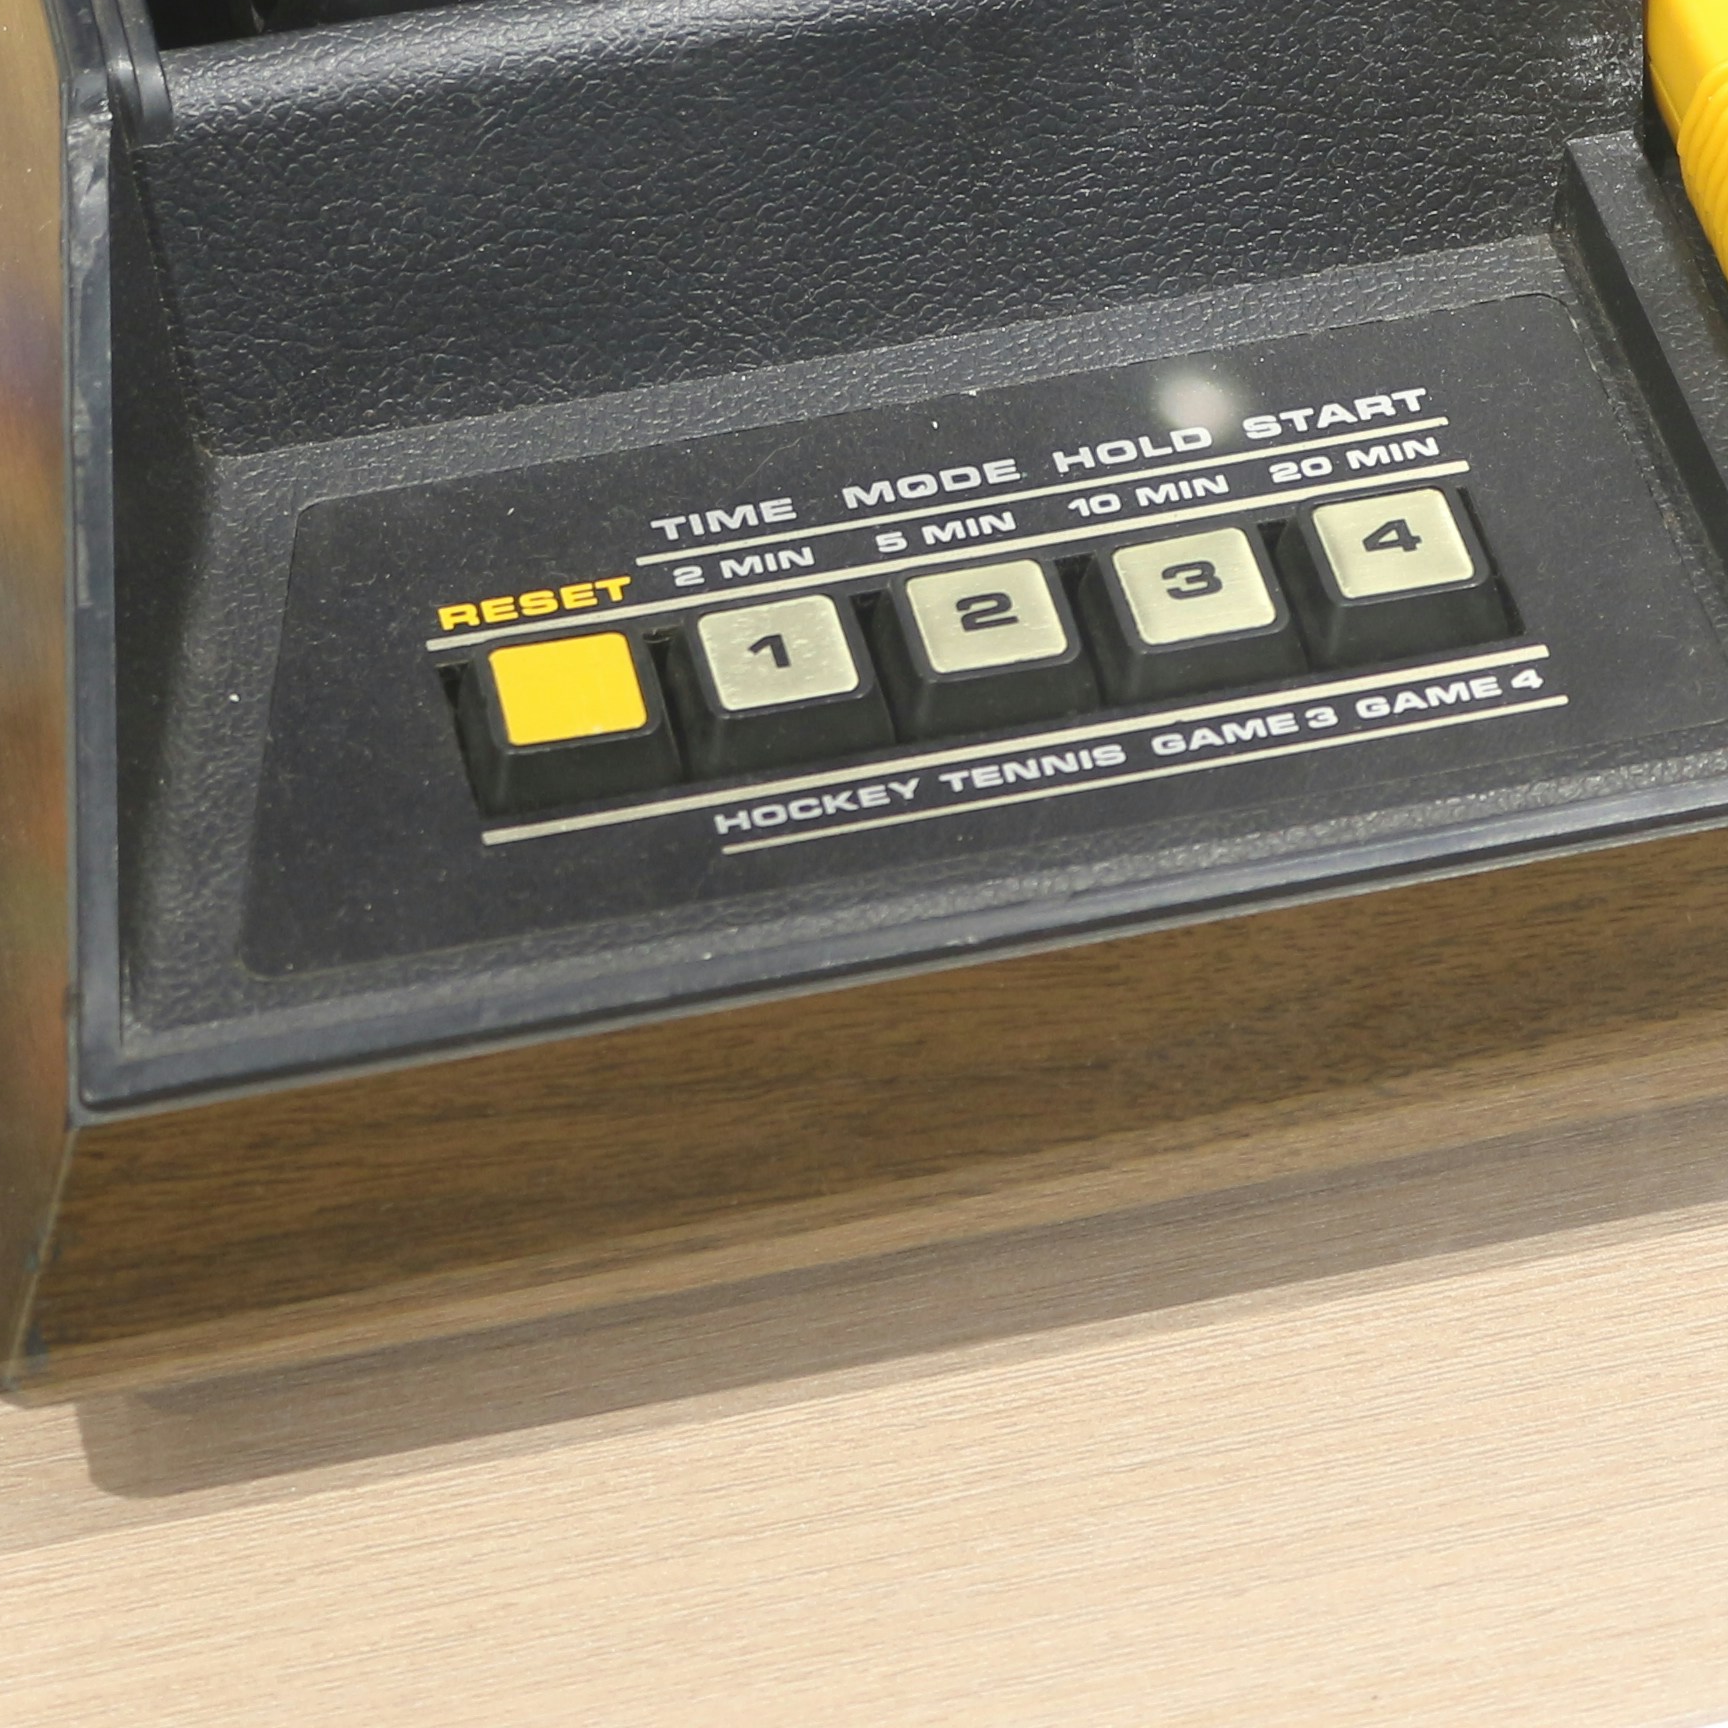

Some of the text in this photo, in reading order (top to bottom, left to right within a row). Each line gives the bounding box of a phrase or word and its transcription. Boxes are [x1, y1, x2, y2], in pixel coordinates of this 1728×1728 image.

[651, 388, 1427, 540] TIME MODE HOLD START
[673, 437, 1440, 587] 2 MIN 5 MIN 10 MIN 20 MIN
[1363, 518, 1422, 553] 4
[438, 576, 632, 630] RESET
[1161, 560, 1223, 600] 3
[956, 593, 1019, 632] 2
[746, 634, 791, 669] 1
[714, 778, 922, 835] HOCKEY
[939, 745, 1127, 793] TENNIS
[1355, 676, 1502, 720] GAME
[1510, 669, 1544, 690] 4
